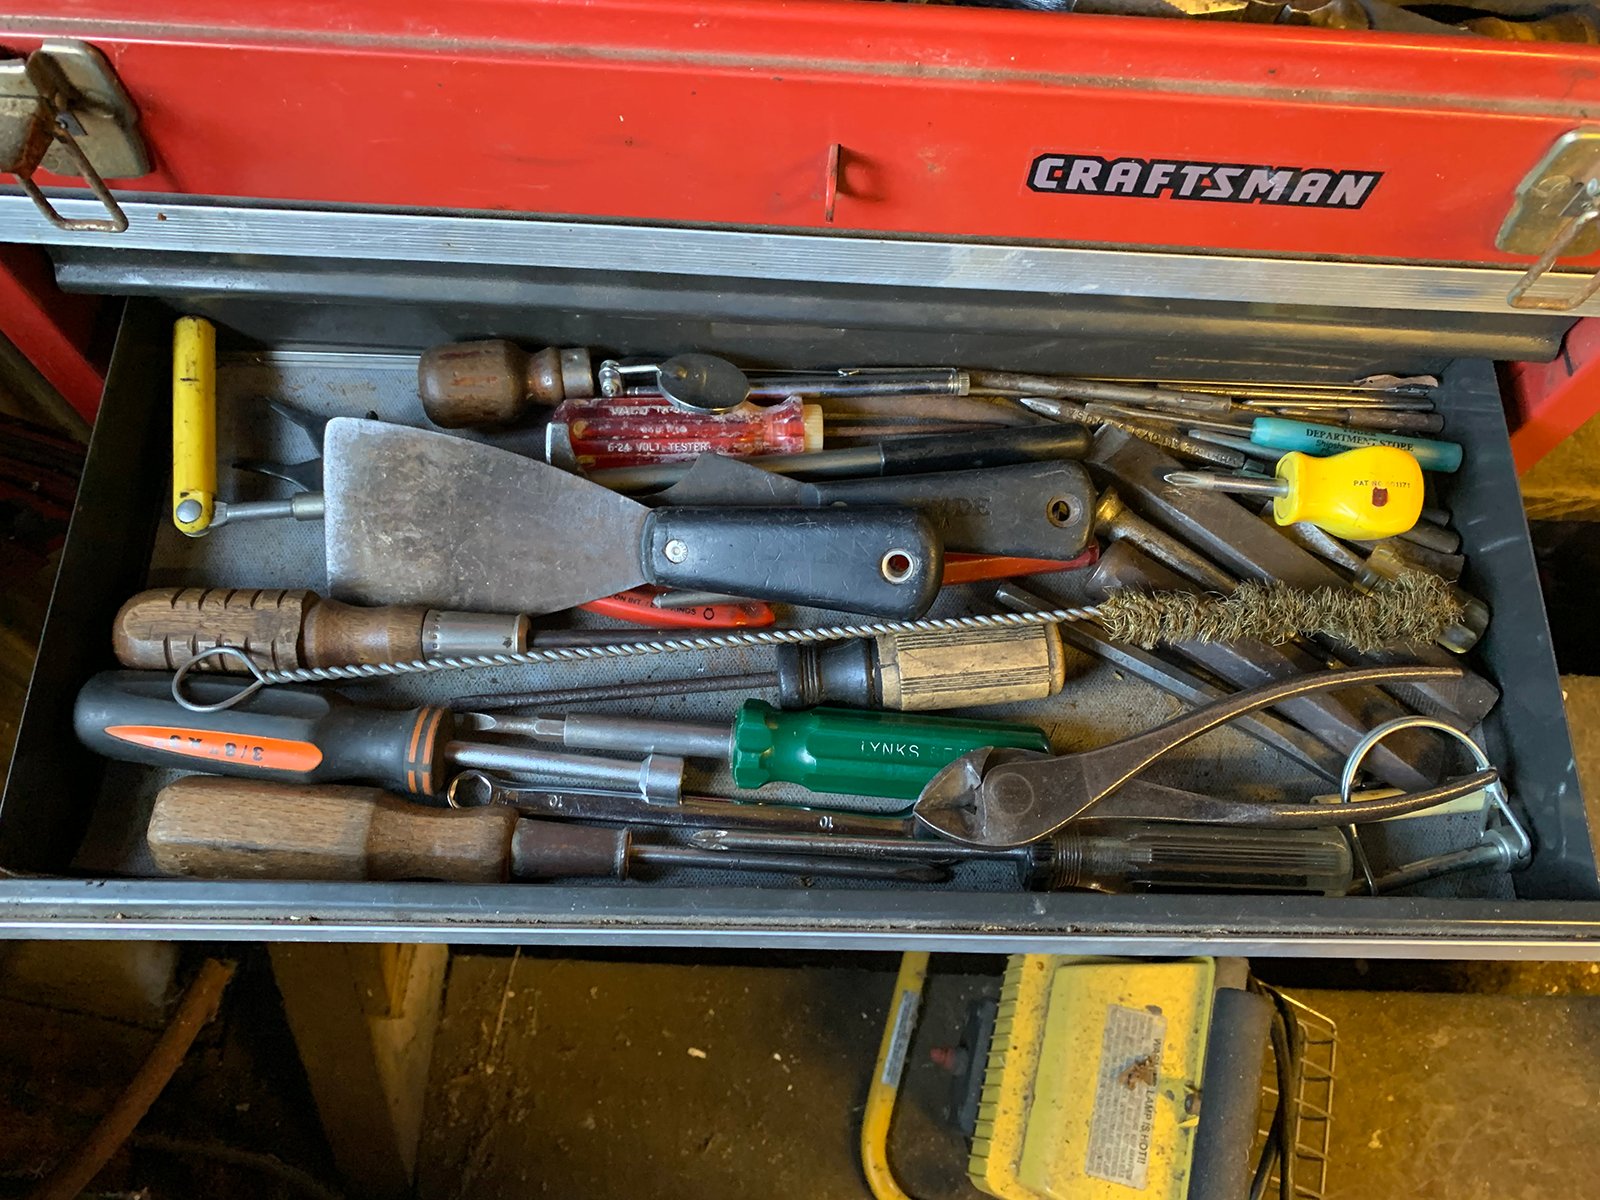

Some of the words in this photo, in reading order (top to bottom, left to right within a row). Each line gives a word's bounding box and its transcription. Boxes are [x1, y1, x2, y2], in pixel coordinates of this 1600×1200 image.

[1033, 157, 1374, 205] CRAFTSMAN
[1306, 428, 1376, 447] DEPARTMENT
[1380, 439, 1415, 452] STORE
[1353, 479, 1369, 487] PAT
[1144, 1089, 1155, 1120] LAMP
[1141, 1121, 1151, 1132] IS
[1137, 1134, 1149, 1165] HOT!!
